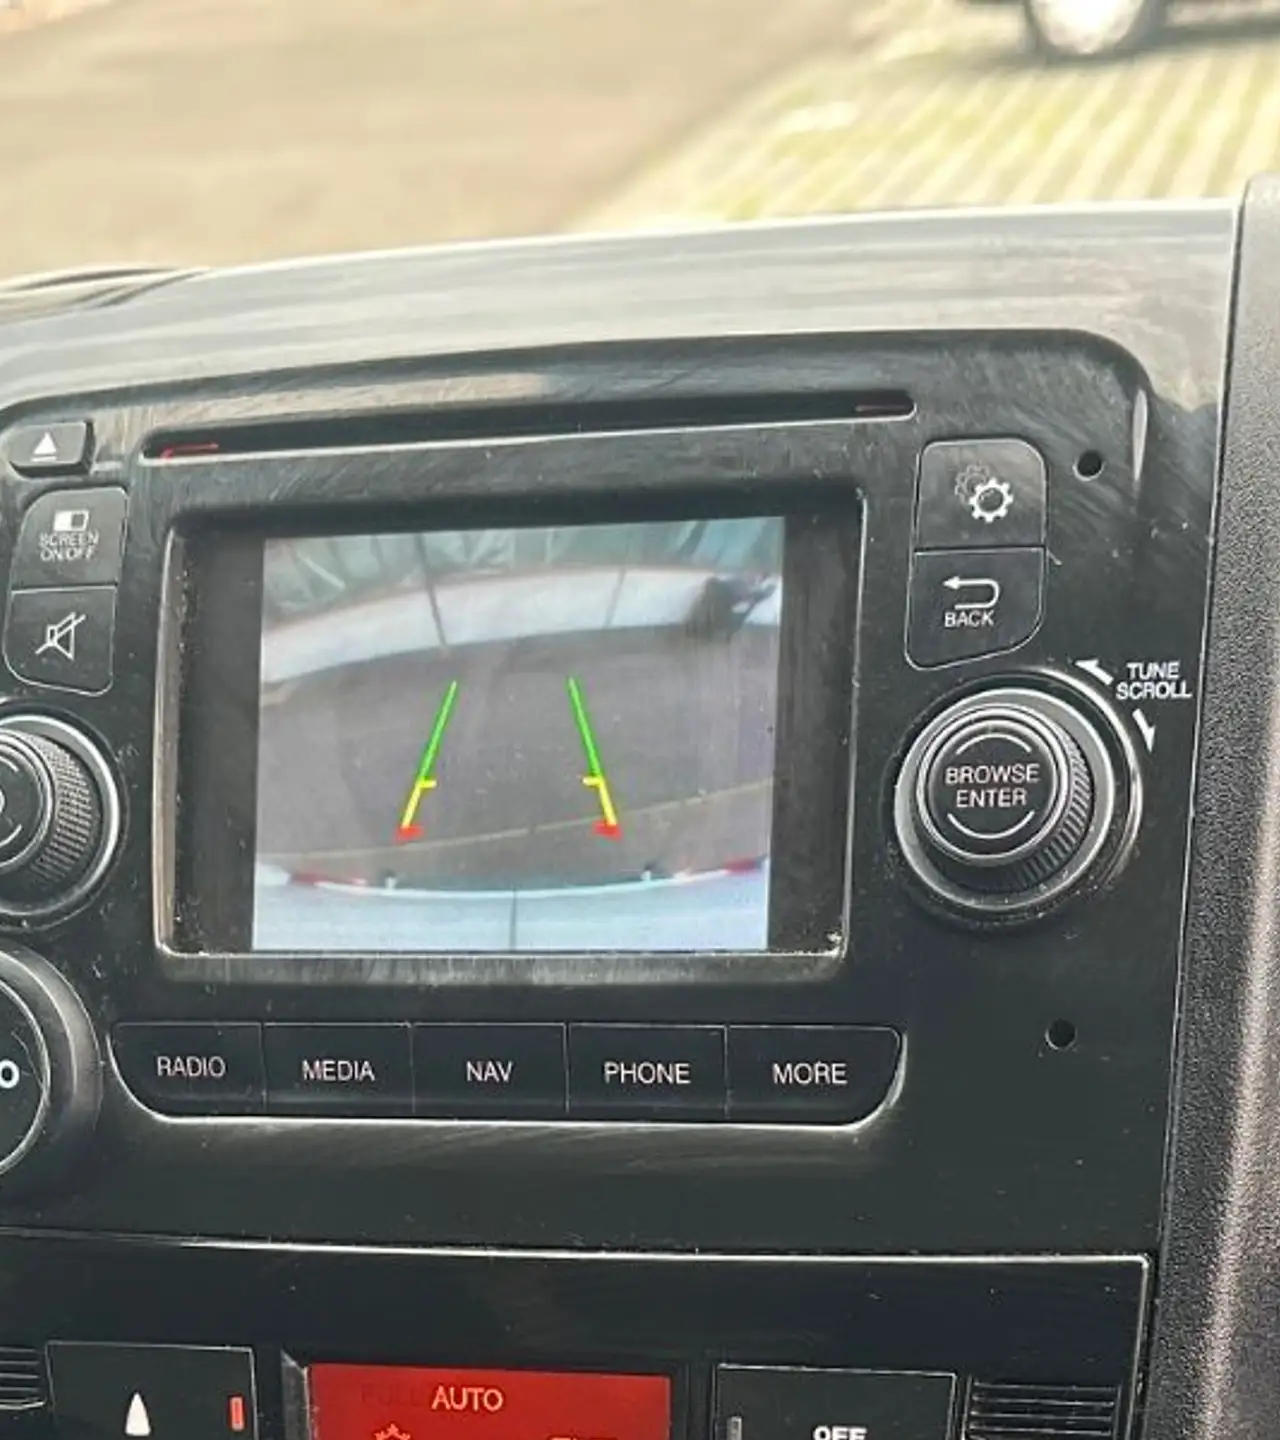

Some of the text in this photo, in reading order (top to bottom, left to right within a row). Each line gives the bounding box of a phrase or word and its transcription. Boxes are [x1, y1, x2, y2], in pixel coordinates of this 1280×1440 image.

[39, 531, 99, 547] SCREEN
[944, 610, 996, 629] BACK
[1126, 661, 1180, 680] TUNE
[1115, 680, 1192, 700] SCROLL
[945, 762, 1040, 786] BROWSE
[956, 786, 1028, 810] ENTER
[157, 1055, 227, 1078] RADIO
[302, 1059, 376, 1082] MEDIA
[466, 1061, 513, 1083] NAV
[604, 1061, 691, 1085] PHONE
[772, 1061, 848, 1085] MORE
[431, 1386, 504, 1412] AUTO
